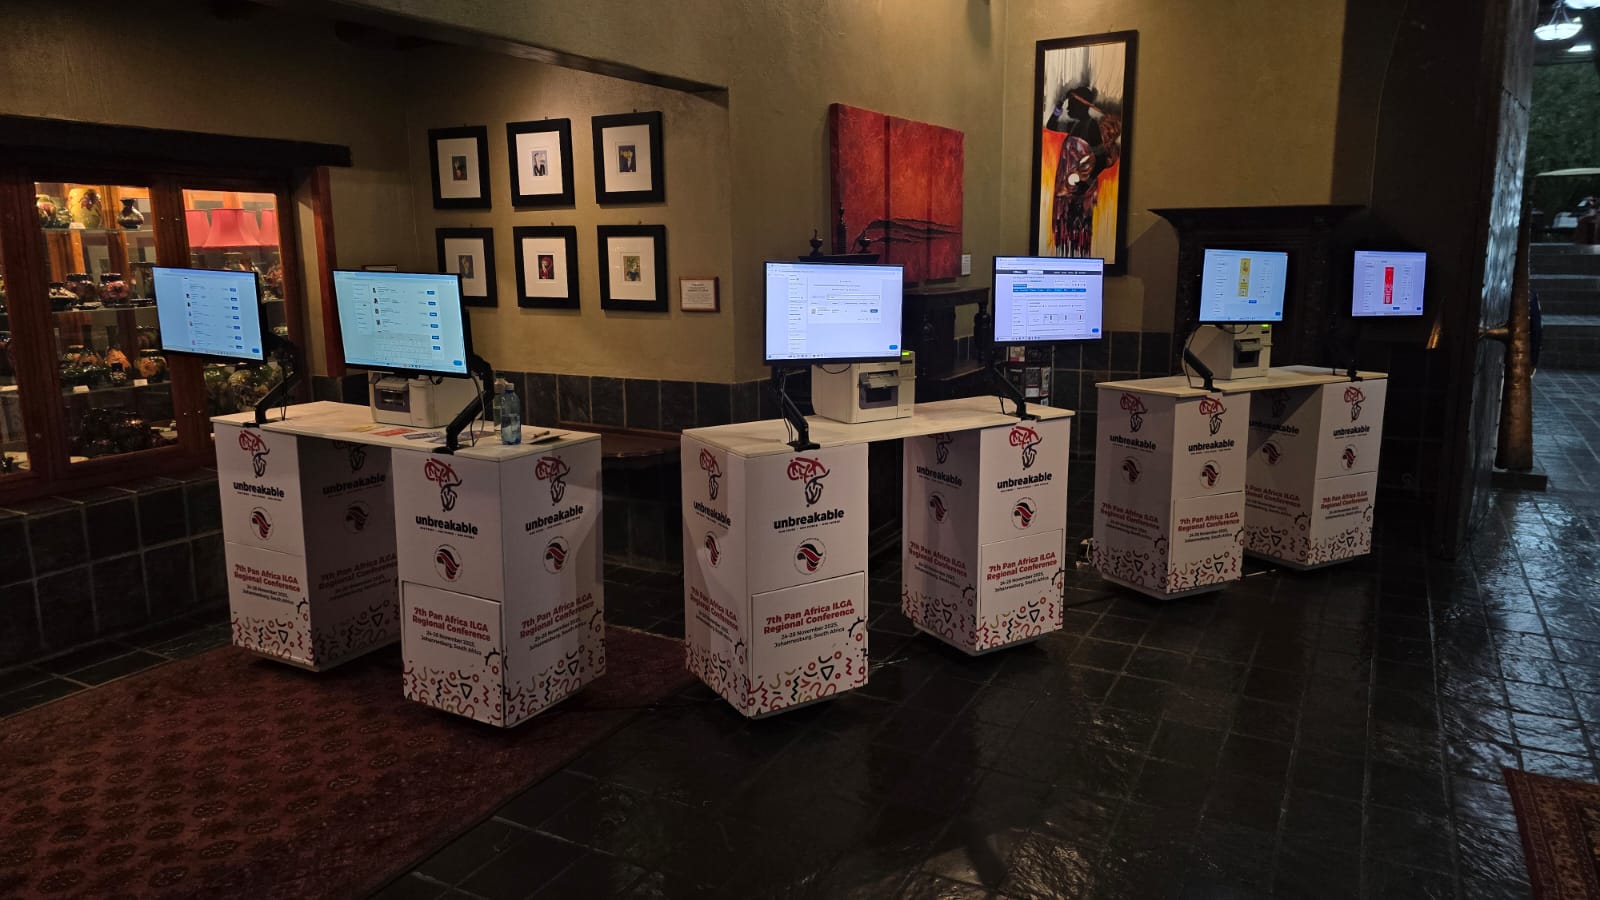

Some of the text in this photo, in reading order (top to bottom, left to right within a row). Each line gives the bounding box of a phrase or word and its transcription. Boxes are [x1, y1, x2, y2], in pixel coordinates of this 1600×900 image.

[1333, 424, 1370, 436] unbreakable
[1109, 434, 1156, 450] unbreakable
[1188, 439, 1235, 452] unbreakable
[322, 472, 386, 495] unbreakable
[916, 465, 963, 488] unbreakable
[997, 472, 1052, 489] unbreakable
[232, 481, 285, 498] unbreakable
[526, 504, 584, 532] unbreakable
[694, 500, 731, 527] unbreakable
[774, 509, 844, 529] unbreakable
[1192, 516, 1204, 524] Pan
[1205, 514, 1223, 522] Africa
[1224, 511, 1239, 519] ILGA
[416, 516, 478, 535] unbreakable
[1178, 518, 1240, 532] Regional Conference
[986, 559, 1057, 581] Regional Conference
[989, 552, 1056, 573] 7th Pan Africa ILGA
[234, 571, 300, 592] Regional Conference
[235, 563, 299, 584] 7th Pan Africa ILGA
[414, 607, 488, 632] 7th Pan Africa ILGA
[520, 601, 594, 639] Regional Conference
[521, 592, 593, 629] 7th Pan Africa ILGA
[766, 600, 852, 625] 7th Pan Africa ILGA
[412, 615, 490, 641] Regional Conference
[763, 608, 855, 635] Regional Conference
